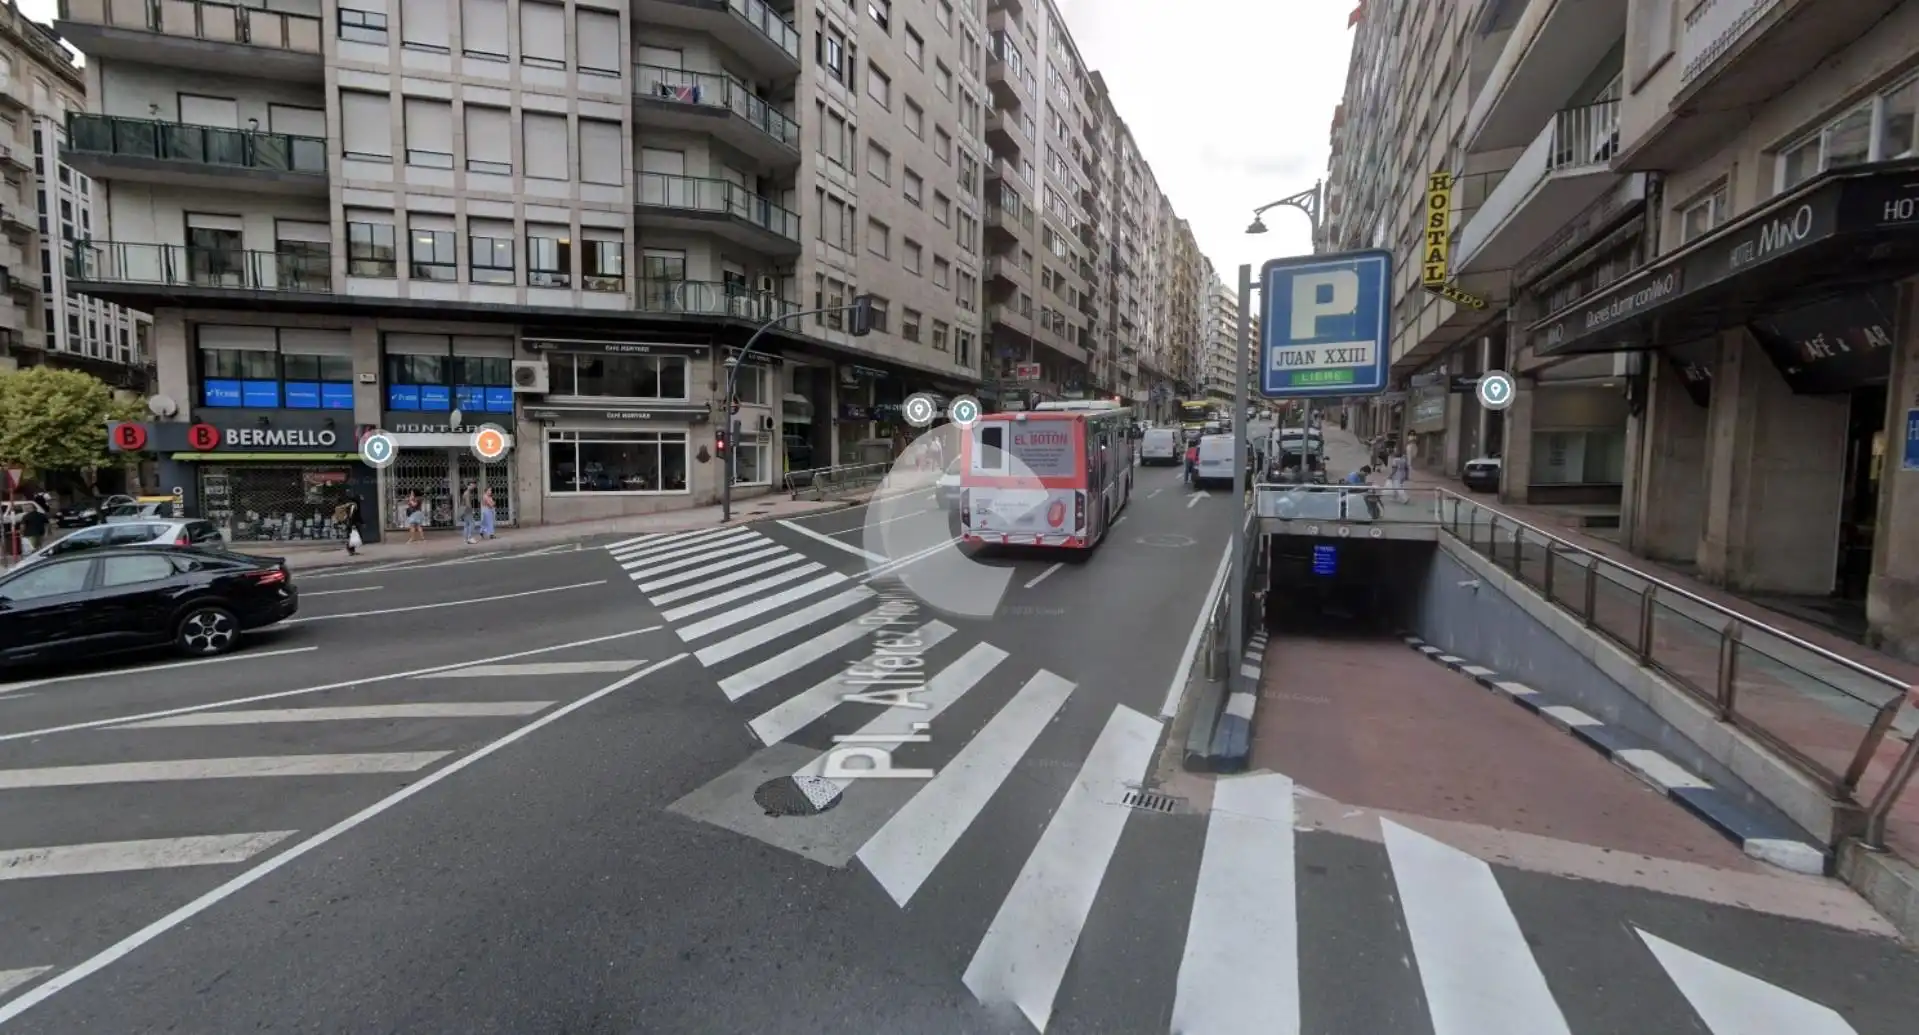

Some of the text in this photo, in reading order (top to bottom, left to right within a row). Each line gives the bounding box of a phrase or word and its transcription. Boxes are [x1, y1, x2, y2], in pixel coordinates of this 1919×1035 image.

[1884, 198, 1919, 221] HO
[1425, 174, 1449, 281] HOSTAL
[1290, 269, 1359, 340] P
[1443, 284, 1484, 310] LIDO
[1277, 347, 1367, 366] JUAN XXIII
[122, 426, 137, 446] B
[196, 426, 336, 447] B BERMELLO
